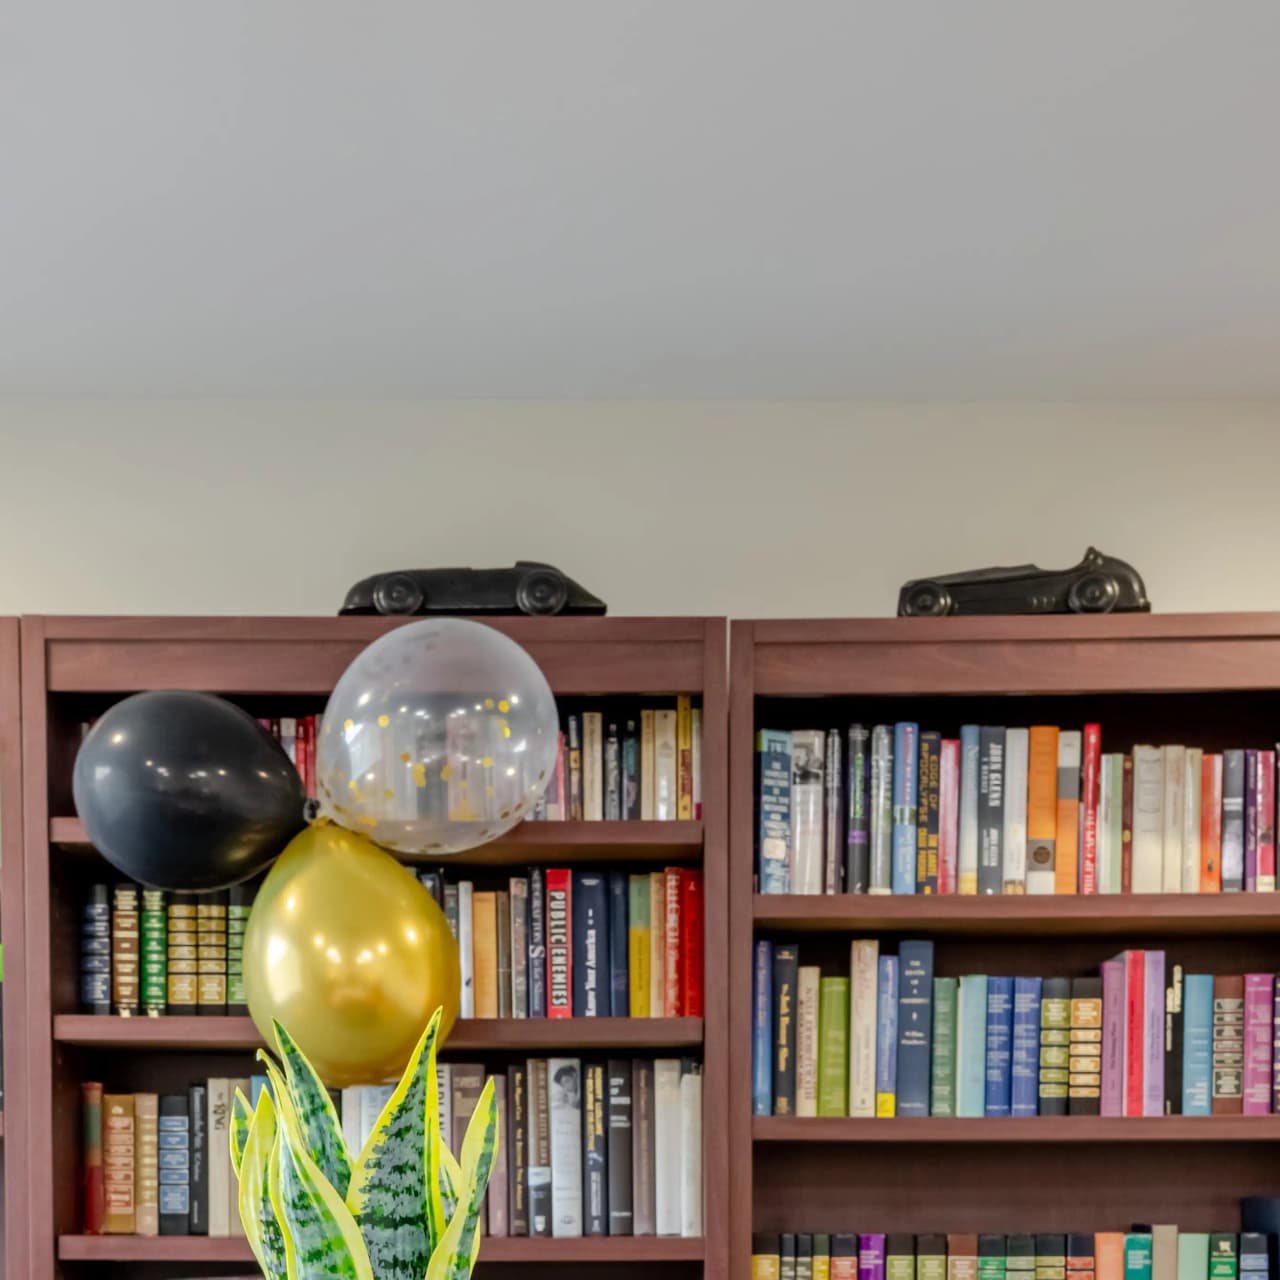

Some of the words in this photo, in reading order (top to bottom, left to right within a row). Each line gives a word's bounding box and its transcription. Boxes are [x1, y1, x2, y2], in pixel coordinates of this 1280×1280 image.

[929, 755, 938, 788] EDGE
[989, 744, 1002, 769] JOHN
[919, 743, 929, 822] APOCALYPSE
[989, 772, 1002, 807] GLENN
[929, 794, 938, 810] OF
[550, 891, 567, 944] PUBLIC
[550, 948, 567, 1007] ENEMIES
